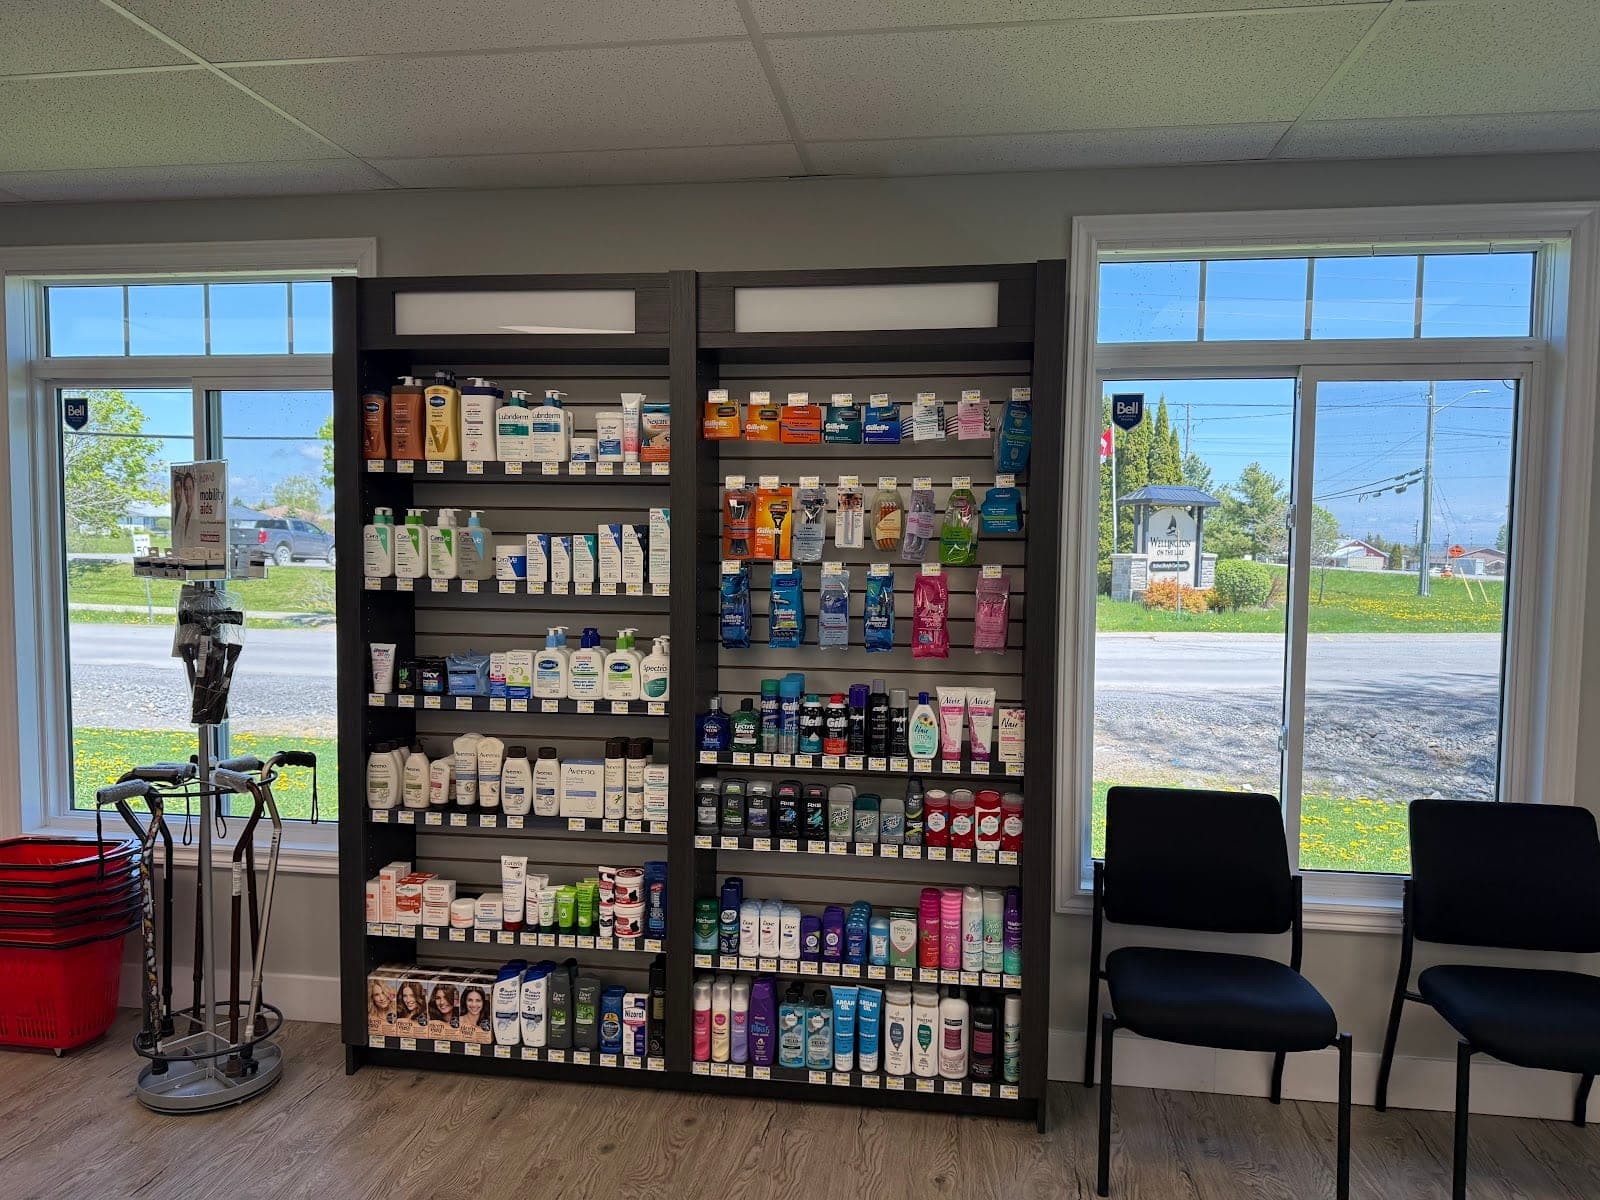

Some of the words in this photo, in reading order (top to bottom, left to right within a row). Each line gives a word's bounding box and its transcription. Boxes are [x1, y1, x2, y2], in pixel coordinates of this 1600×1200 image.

[67, 404, 85, 417] Bell
[1116, 401, 1139, 415] Bell
[498, 412, 529, 421] Lubriderm
[746, 423, 769, 431] Gillette
[825, 422, 849, 431] Gillette
[199, 487, 225, 504] mobility
[199, 502, 213, 515] aids
[756, 527, 783, 535] Gillette
[642, 663, 668, 673] Spectro
[734, 722, 755, 730] Lectric
[567, 767, 596, 776] Aveeno
[859, 1000, 877, 1008] ARGAN
[625, 1009, 644, 1019] Nizoral
